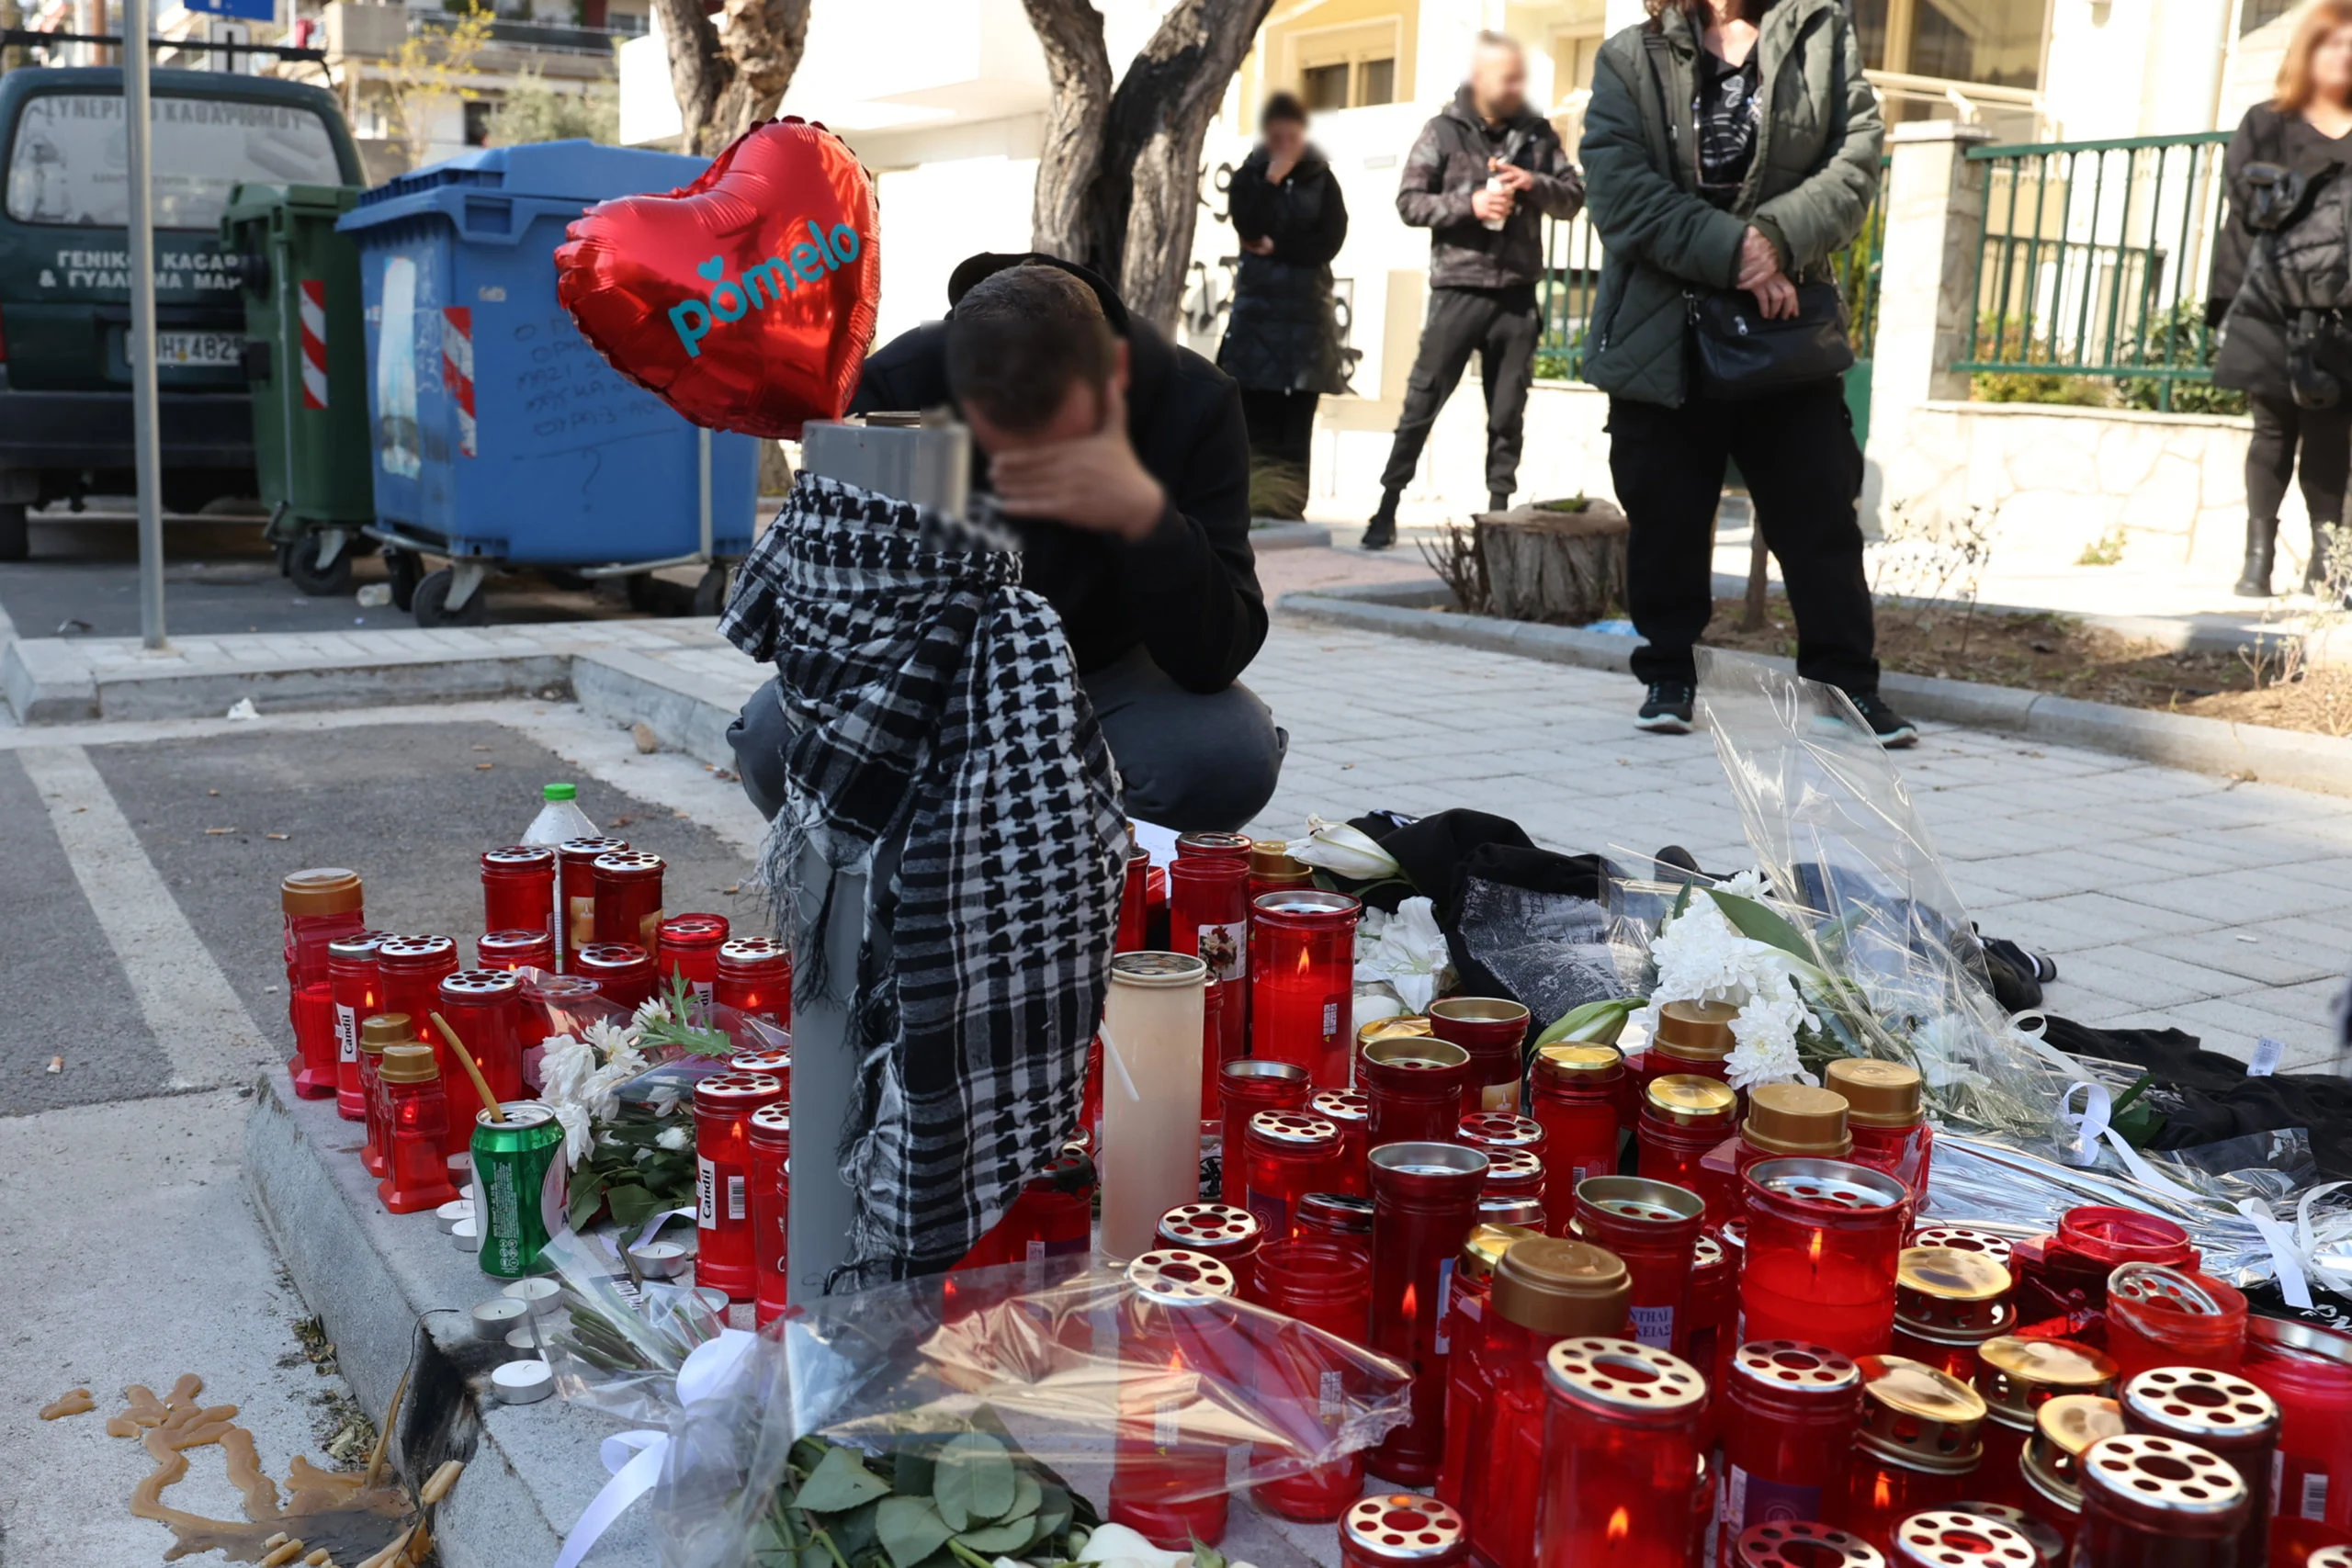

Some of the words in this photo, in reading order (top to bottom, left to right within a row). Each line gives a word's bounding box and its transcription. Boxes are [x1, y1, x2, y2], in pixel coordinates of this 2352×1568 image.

[668, 220, 860, 358] pomelo
[342, 1014, 354, 1055] Candil
[701, 1168, 712, 1219] Candil
